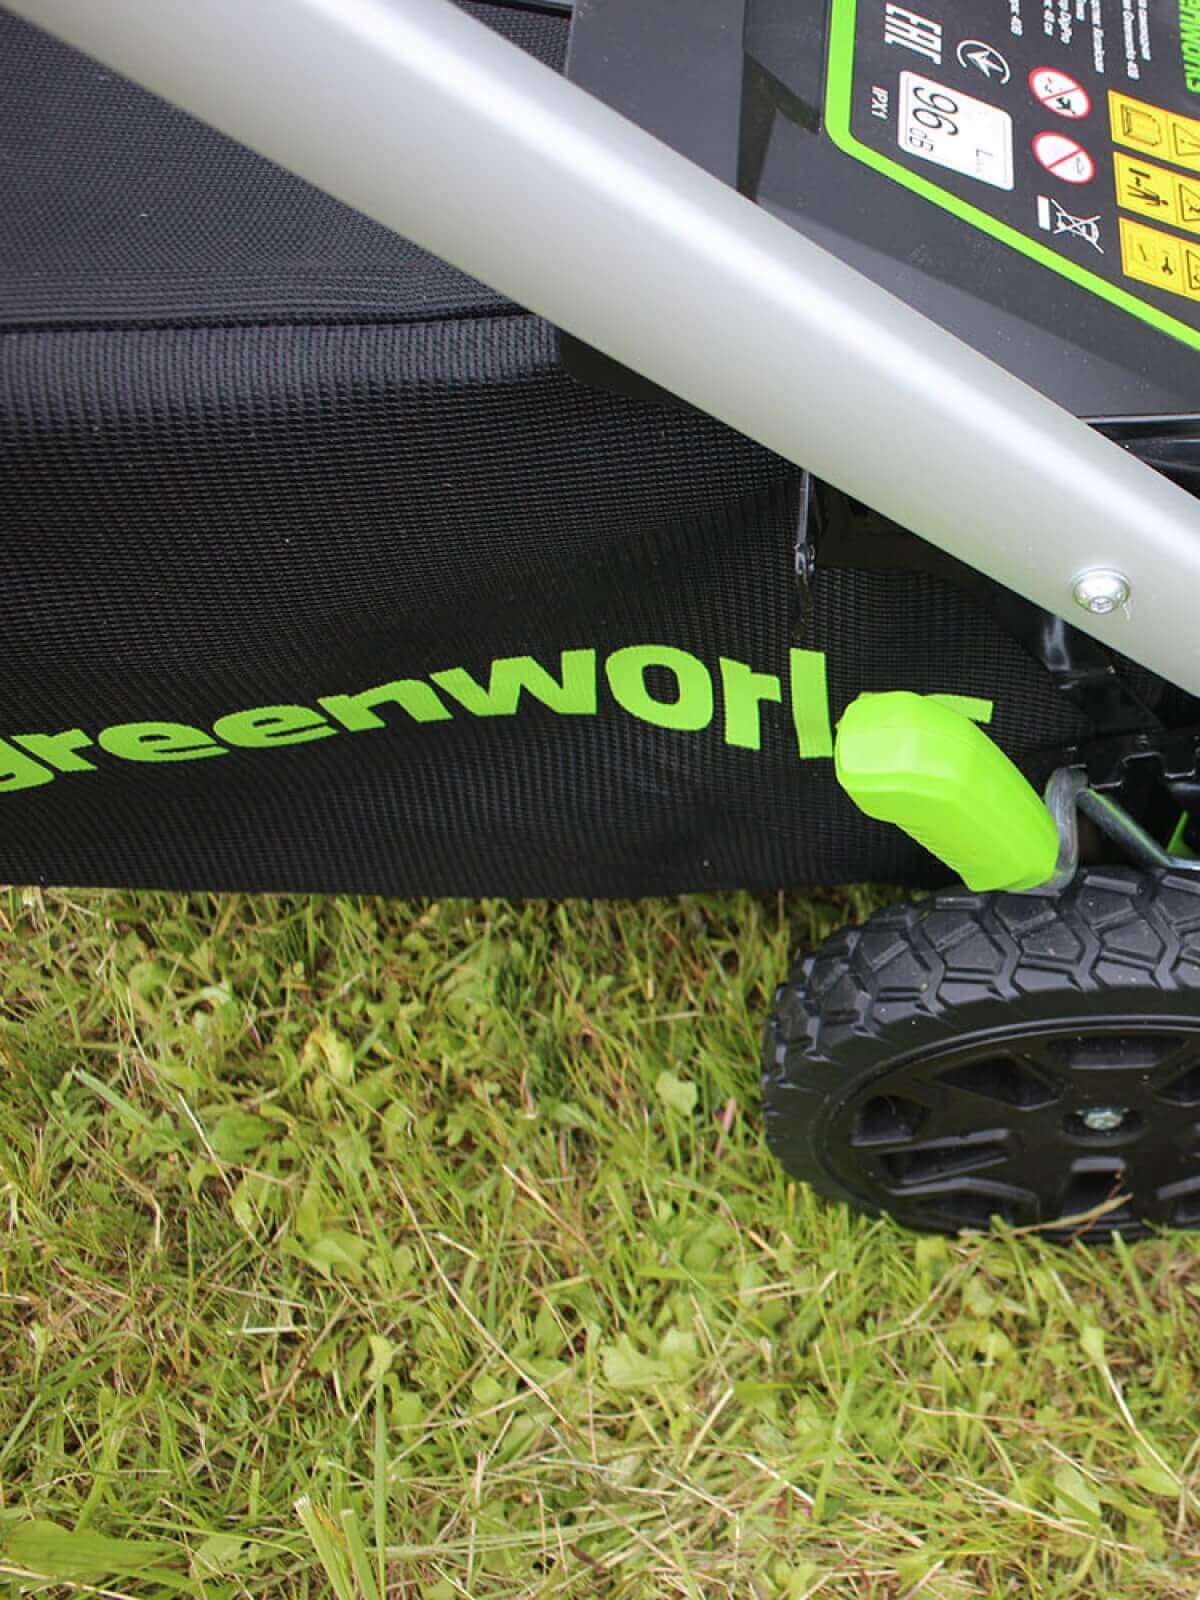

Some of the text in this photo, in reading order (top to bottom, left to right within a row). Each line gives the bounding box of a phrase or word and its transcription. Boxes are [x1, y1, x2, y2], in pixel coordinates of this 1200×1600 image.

[871, 86, 889, 120] IPX1
[912, 86, 959, 136] 96
[0, 648, 994, 792] reenwor
